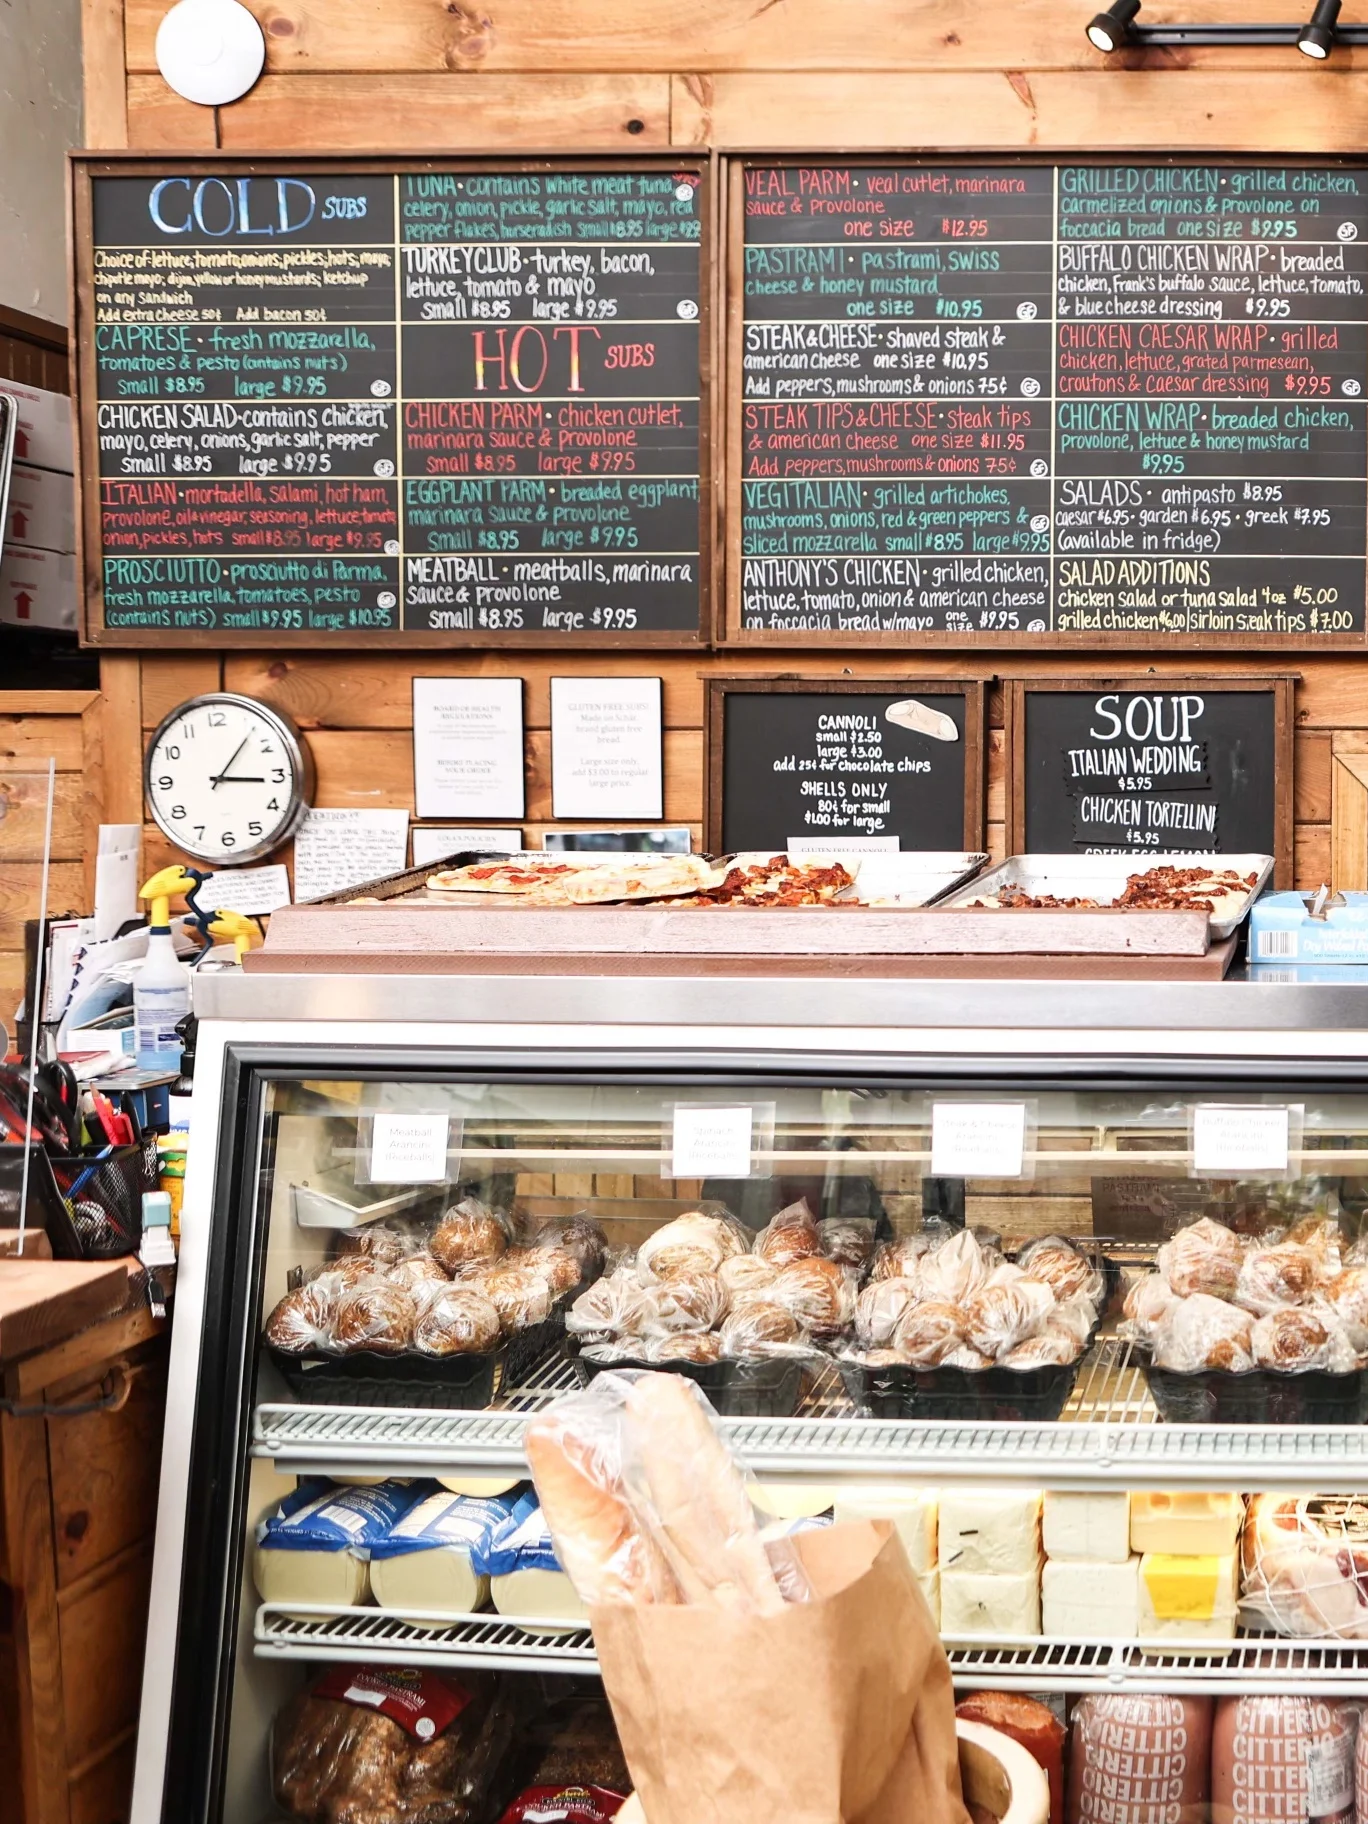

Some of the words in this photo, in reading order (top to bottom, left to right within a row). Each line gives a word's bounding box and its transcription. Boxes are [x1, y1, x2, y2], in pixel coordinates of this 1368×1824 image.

[745, 171, 794, 196] VEAL
[800, 170, 850, 195] PARM
[867, 173, 899, 193] veal
[902, 173, 952, 195] cutlet,
[956, 176, 1025, 193] marinara
[1061, 168, 1139, 193] GRILLED
[1143, 168, 1218, 192] CHICKEN
[1231, 170, 1286, 195] grilled
[1292, 174, 1358, 195] chicken,
[149, 178, 315, 236] COLD
[322, 196, 367, 219] SUBS
[1059, 245, 1131, 272] BUFFALO
[1137, 245, 1209, 272] CHICKEN
[1214, 245, 1268, 272] WRAP
[1281, 247, 1344, 272] breaded
[96, 326, 196, 353] CAPRESE
[208, 327, 262, 350] fresh
[269, 327, 375, 351] mozzarella,
[1059, 324, 1131, 349] CHICKEN
[1139, 324, 1208, 349] CAESAR
[1214, 324, 1268, 350] WRAP
[1281, 326, 1338, 352] grilled
[472, 326, 602, 392] HOT
[604, 344, 654, 368] SUBS
[98, 404, 178, 429] CHICKEN
[181, 404, 237, 429] SALAD
[406, 402, 484, 428] CHICKEN
[492, 402, 542, 427] PARM
[558, 405, 624, 426] chicken
[628, 404, 683, 428] cutlet,
[1059, 403, 1138, 431] CHICKEN
[1145, 403, 1200, 431] WRAP
[1213, 405, 1278, 430] breaded
[1284, 404, 1353, 432] chicken,
[1060, 481, 1142, 506] SALADS
[1162, 484, 1235, 510] antipasto
[1243, 482, 1282, 501] $8.95
[105, 558, 220, 584] PROSCIUTTO
[230, 562, 308, 583] prosciutto
[312, 561, 329, 580] di
[332, 560, 387, 582] Parma,
[407, 558, 500, 582] MEATBALL
[612, 561, 692, 582] marinara
[1059, 560, 1115, 586] SALAD
[1117, 560, 1210, 586] ADDITIONS
[429, 607, 473, 628] small
[479, 608, 523, 627] $8.95
[542, 608, 584, 630] large
[591, 608, 637, 628] $9.95
[208, 712, 227, 728] 12
[818, 715, 877, 730] CANNOLI
[1090, 695, 1205, 743] SOUP
[184, 724, 195, 739] 11
[816, 731, 847, 742] small
[850, 732, 882, 743] $2.50
[165, 745, 180, 760] 10
[817, 745, 847, 762] large
[851, 746, 882, 758] $3.00
[1068, 747, 1127, 777] ITALIAN
[1130, 745, 1200, 775] WEDDING
[158, 776, 173, 790] 9
[271, 768, 285, 784] 3
[1118, 776, 1152, 791] $5.95
[800, 781, 846, 796] SHELLS
[852, 782, 887, 799] ONLY
[171, 805, 187, 820] 8
[267, 798, 279, 812] 4
[1081, 796, 1141, 826] CHICKEN
[1145, 800, 1216, 833] TORTELLINI
[194, 826, 205, 840] 7
[221, 831, 235, 847] 6
[248, 821, 263, 836] 5
[1126, 828, 1159, 845] $5.95
